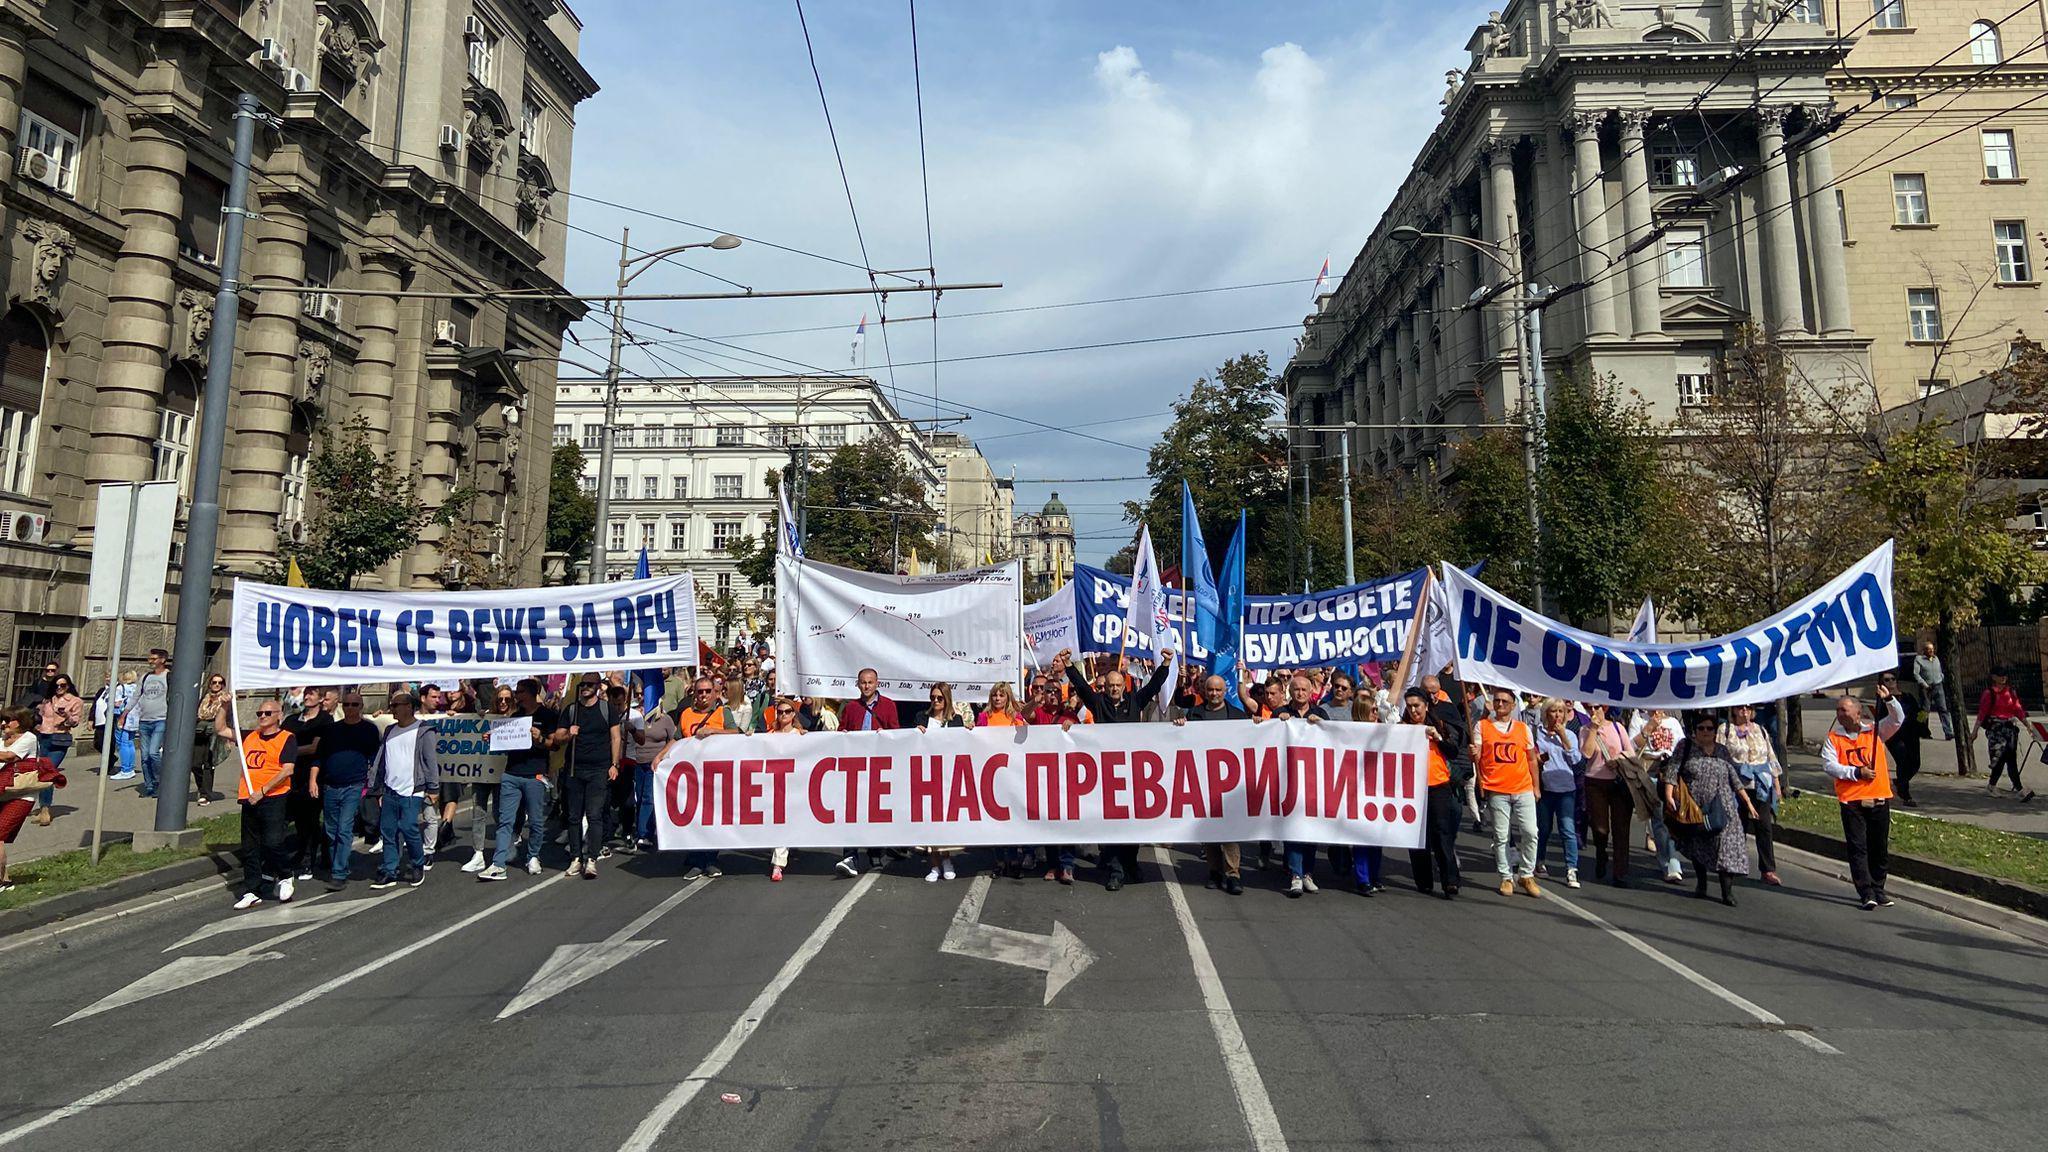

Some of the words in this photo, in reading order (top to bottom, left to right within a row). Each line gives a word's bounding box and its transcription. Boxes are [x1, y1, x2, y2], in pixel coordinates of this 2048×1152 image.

[256, 602, 384, 670] ЧОВЕК
[396, 609, 436, 665] СЕ
[448, 606, 550, 663] ВЕЖЕ
[559, 602, 604, 662] ЗА
[613, 589, 679, 658] РЕЧ
[1250, 579, 1412, 625] ПРОСВЕТЕ
[1458, 589, 1522, 668] НЕ
[1542, 572, 1892, 701] ОДУСТАЈЕМО
[665, 758, 795, 827] ОПЕТ
[808, 756, 893, 824] СТЕ
[909, 753, 1011, 823] НАС
[1025, 746, 1417, 824] ПРЕВАРИЛИ!!!
